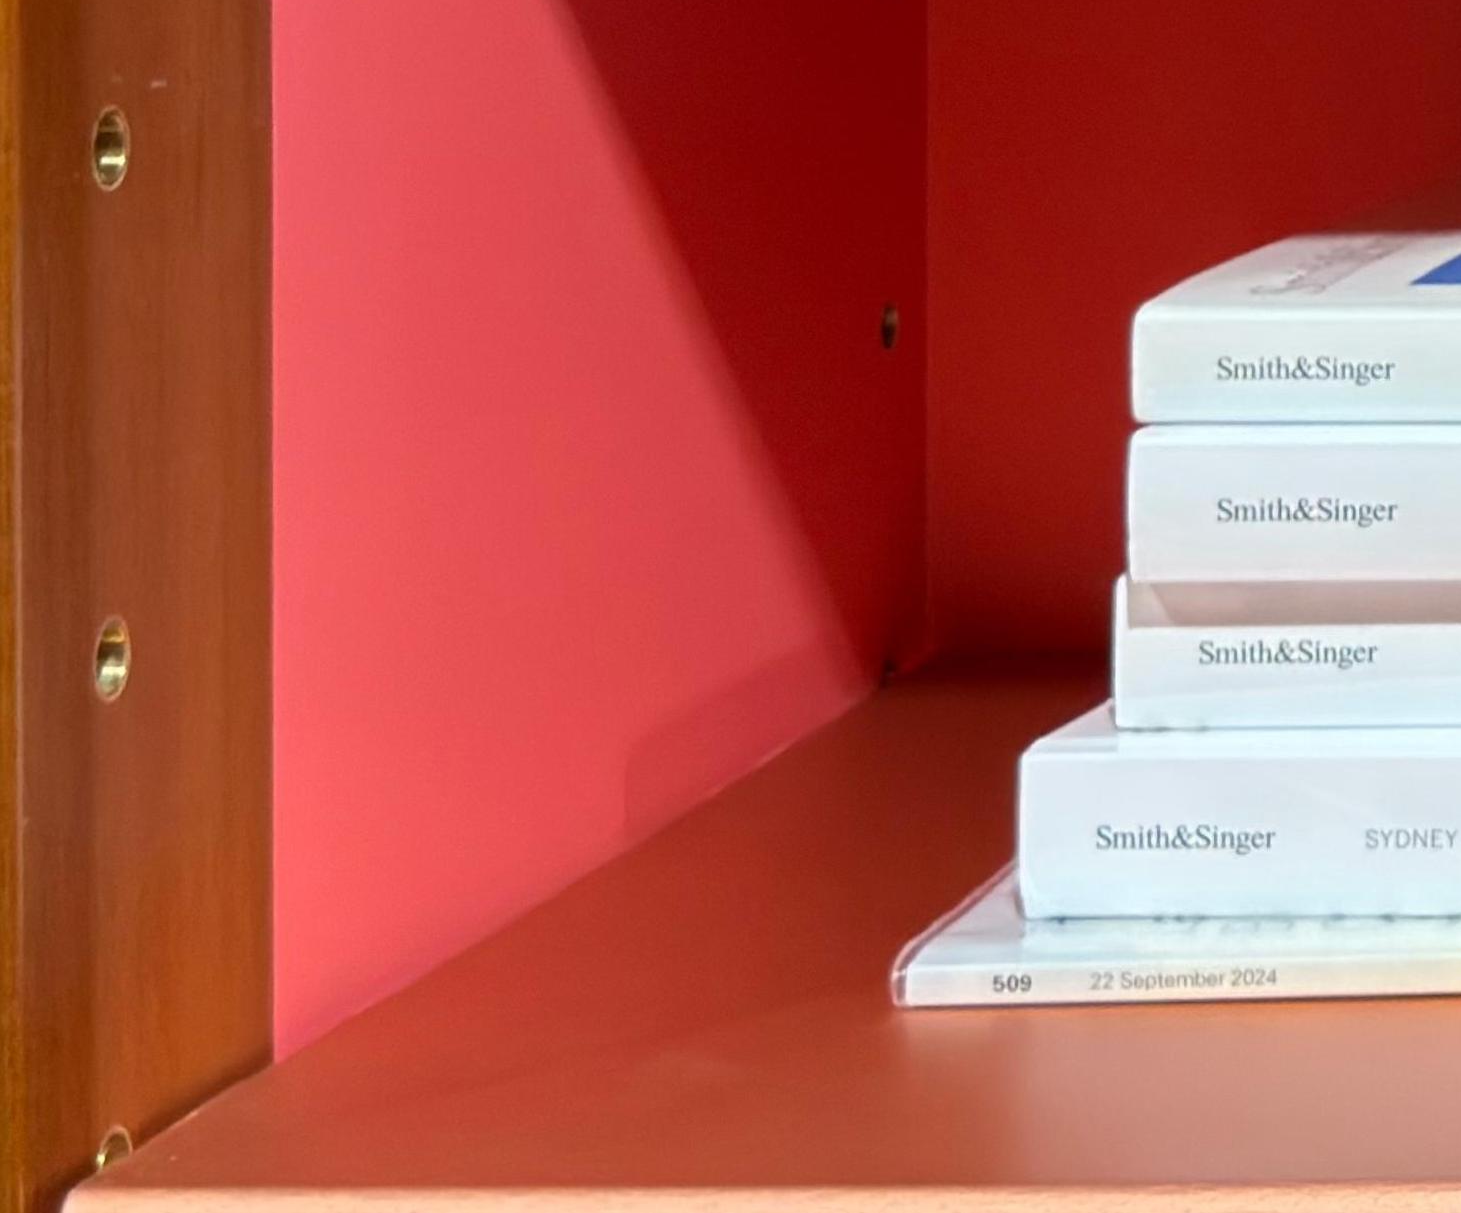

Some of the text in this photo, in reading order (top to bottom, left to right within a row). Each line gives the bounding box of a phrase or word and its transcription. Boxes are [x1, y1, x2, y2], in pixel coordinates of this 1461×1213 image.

[1217, 355, 1395, 387] Smith&Singer
[1216, 497, 1398, 529] Smith&Singer
[1198, 639, 1378, 671] Smith&Singer
[1096, 824, 1276, 856] Smith&Singer
[1365, 827, 1457, 850] SYDNEY
[992, 974, 1032, 994] 509
[1089, 968, 1278, 992] 22 September 2024
